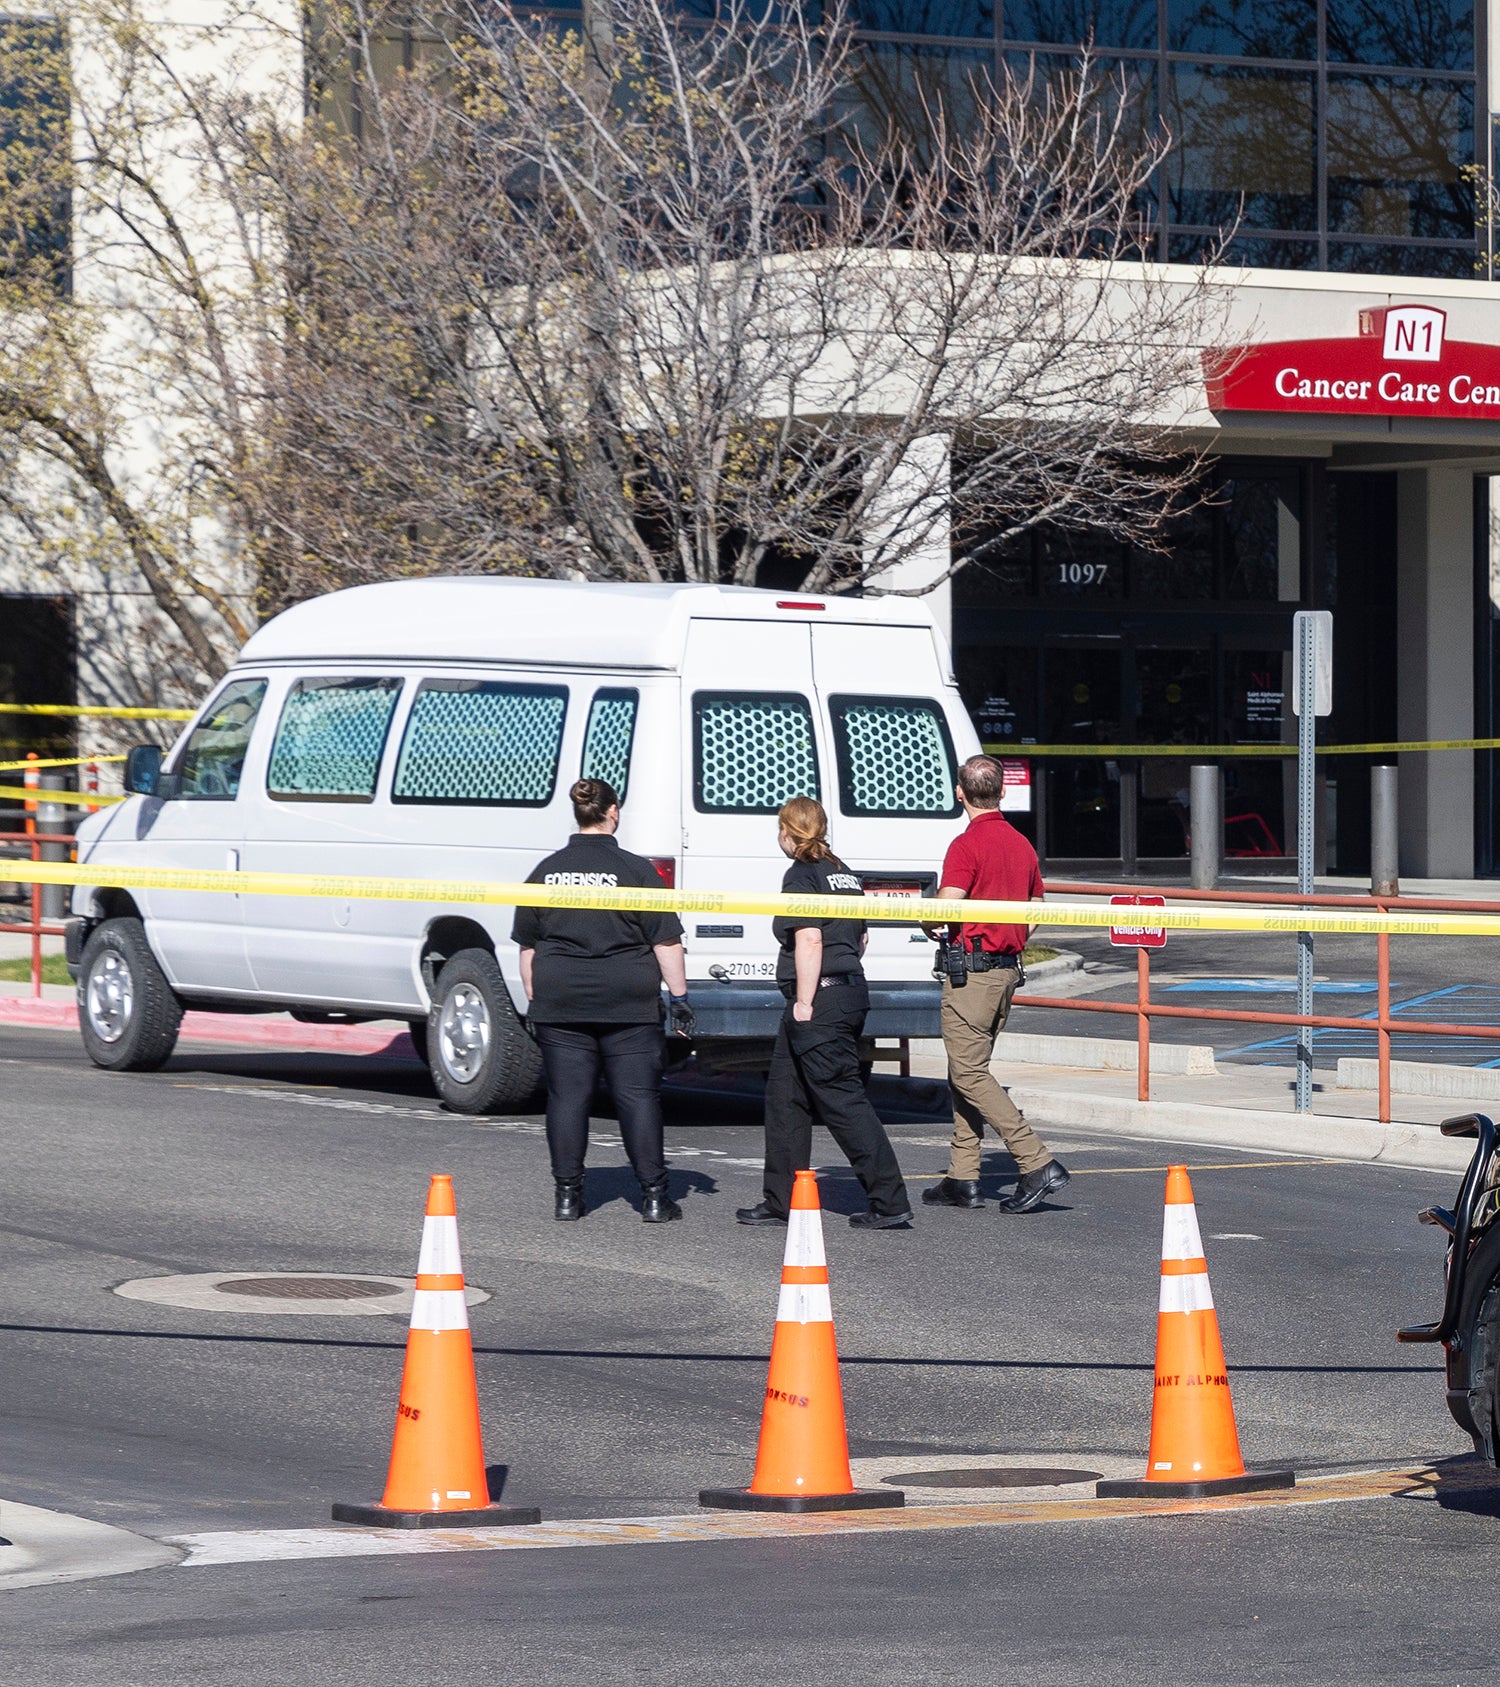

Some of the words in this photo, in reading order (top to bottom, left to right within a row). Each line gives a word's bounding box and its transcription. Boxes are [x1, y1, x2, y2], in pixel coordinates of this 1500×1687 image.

[1395, 318, 1433, 353] N1
[1274, 368, 1371, 401] Cancer
[1378, 372, 1440, 404] Care
[1059, 563, 1108, 585] 1097
[544, 872, 618, 887] FORENSICS
[729, 963, 775, 976] 2701-92
